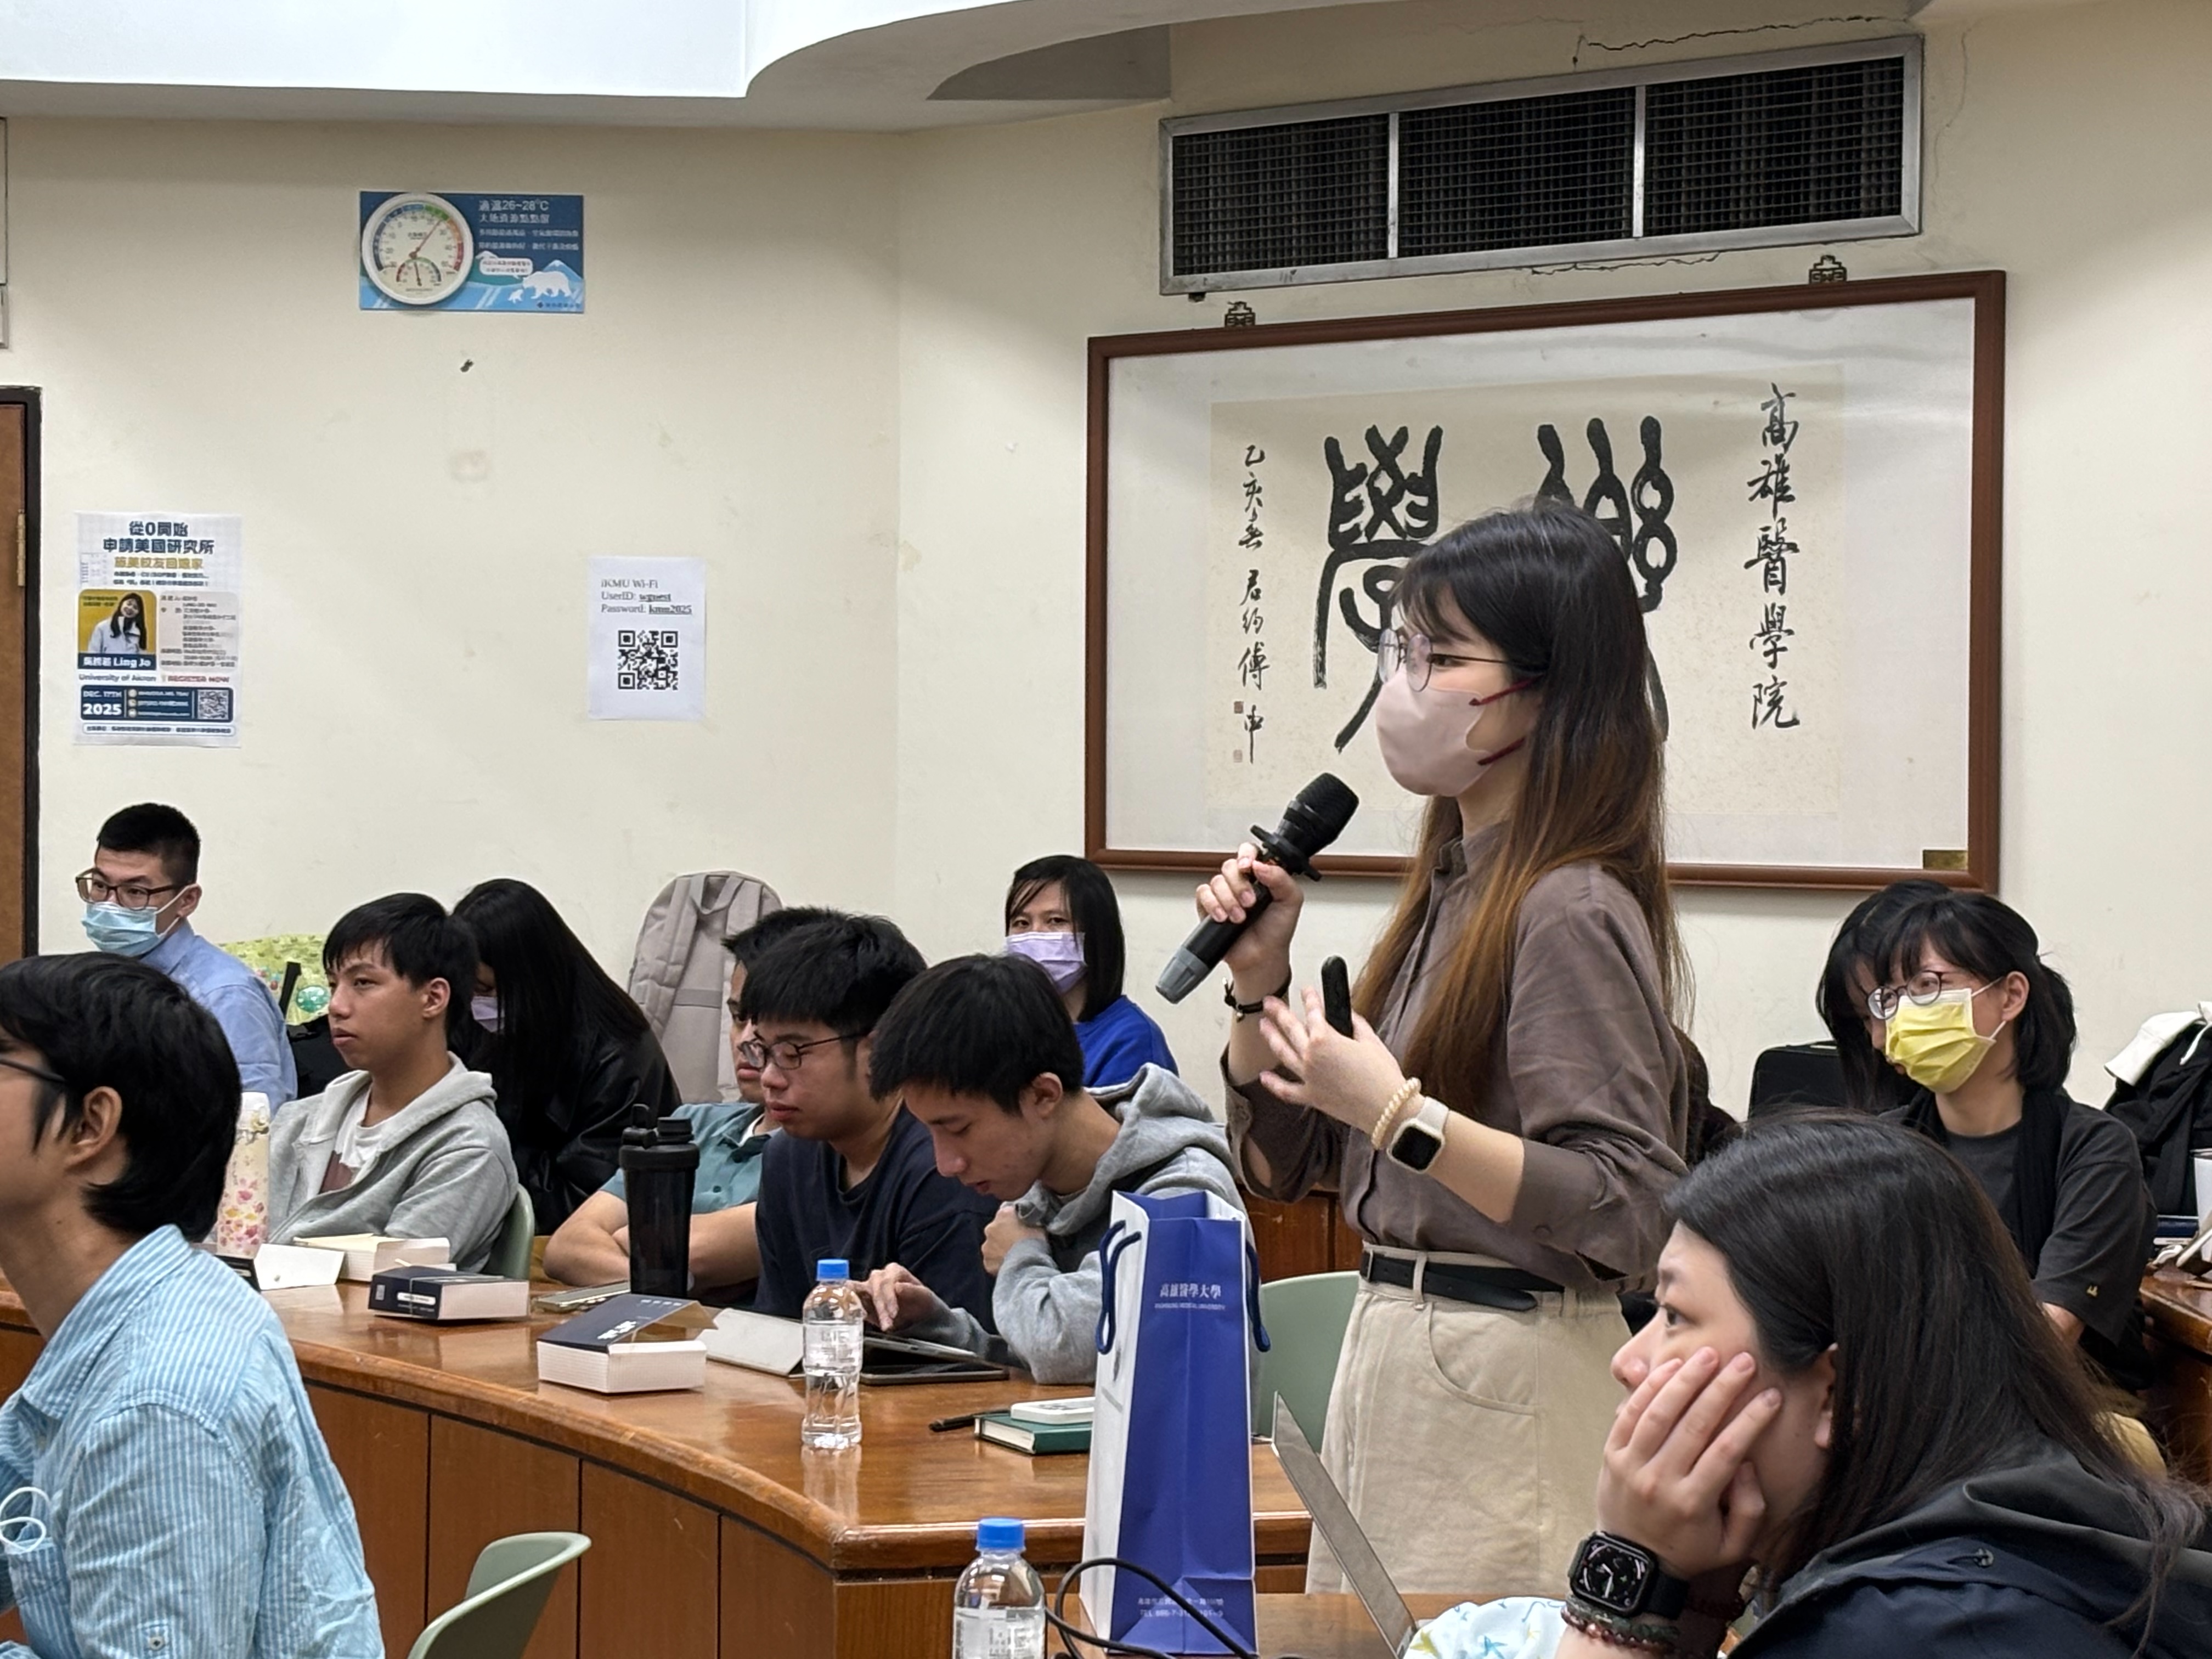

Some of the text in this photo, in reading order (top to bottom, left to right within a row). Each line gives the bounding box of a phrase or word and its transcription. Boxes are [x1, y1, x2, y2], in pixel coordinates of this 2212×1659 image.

[129, 521, 188, 537] 從0開始
[103, 538, 215, 554] 申請美國研究所
[1744, 382, 1801, 730] 高雄醫學院
[632, 579, 658, 589] Wi-Fi
[114, 657, 137, 668] Ling
[78, 673, 120, 682] University
[83, 703, 122, 715] 2025
